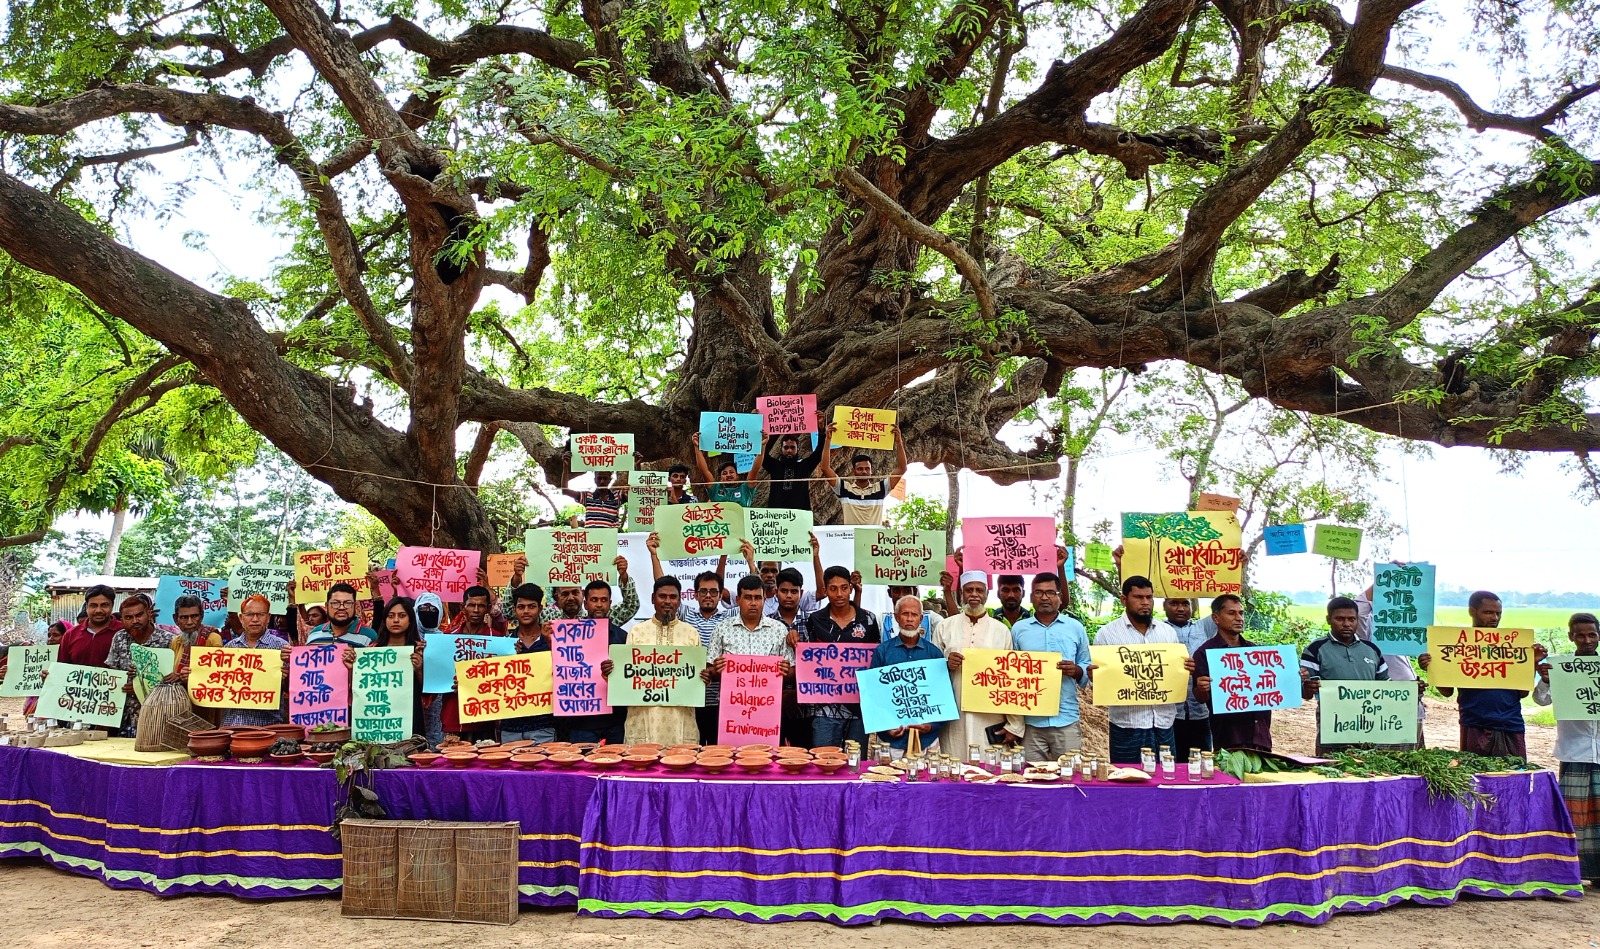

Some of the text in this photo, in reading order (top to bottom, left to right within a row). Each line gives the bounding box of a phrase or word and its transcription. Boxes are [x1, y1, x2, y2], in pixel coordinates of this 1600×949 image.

[767, 396, 803, 408] Biological
[773, 405, 804, 416] Diversity
[718, 416, 736, 426] Our
[768, 414, 804, 422] for future
[718, 424, 736, 432] Life
[770, 422, 807, 432] happy life
[575, 435, 616, 445] একটি গাছ
[718, 430, 749, 440] Depends
[578, 445, 602, 454] হাজার
[715, 441, 752, 452] Biodiversity
[582, 456, 616, 467] আবাস
[750, 510, 796, 521] Biodiversity
[683, 520, 730, 538] প্রকৃতির
[751, 527, 788, 536] Valuable
[985, 523, 1031, 536] আমরা
[549, 531, 589, 542] বাংলার
[753, 536, 786, 545] assets
[878, 532, 918, 545] Protect
[791, 545, 810, 554] them
[871, 544, 932, 561] Biodiversity
[300, 553, 325, 564] সকল
[894, 557, 909, 568] for
[986, 559, 1039, 570] করব রক্ষা
[311, 562, 353, 578] জন্য চাই
[421, 567, 447, 579] রক্ষা
[564, 563, 586, 574] ধান
[875, 564, 928, 581] happy life
[1166, 565, 1218, 579] মানে টিকে
[445, 575, 471, 592] দাবি
[1376, 566, 1423, 587] একটি
[1170, 578, 1204, 592] থাকার
[1383, 589, 1414, 606] গাছ
[1374, 606, 1417, 624] একটি
[553, 619, 596, 643] একটি
[1458, 630, 1518, 646] A Day of
[455, 638, 492, 649] সকল
[25, 649, 51, 663] Protect
[295, 644, 337, 668] একটি
[358, 649, 397, 672] প্রকৃতি
[557, 645, 588, 668] গাছ
[632, 648, 682, 665] Protect
[801, 644, 838, 666] প্রকৃতি
[1116, 646, 1166, 663] নিরাপদ
[1220, 650, 1284, 673] গাছ আছে
[24, 664, 42, 673] Every
[238, 654, 266, 672] গাছ
[504, 659, 534, 677] গাছ
[1457, 658, 1514, 679] উৎসব
[23, 672, 41, 682] Speci
[207, 668, 253, 688] প্রকৃতির
[556, 664, 593, 680] হাজার
[624, 663, 695, 679] Biodiversity
[814, 667, 837, 682] গাছ
[1124, 664, 1168, 680] খাদ্যের
[33, 681, 44, 690] Wo
[359, 670, 403, 689] রক্ষায়
[478, 674, 527, 696] প্রকৃতির
[633, 676, 678, 689] Protect
[736, 675, 768, 687] is the
[1017, 677, 1044, 691] প্রাণ
[1132, 679, 1163, 691] জন্য
[1219, 670, 1276, 693] বলেই নদী
[192, 683, 275, 704] জীবন্ত ইতিহাস
[293, 684, 334, 706] একটি
[557, 682, 596, 698] প্রাণের
[643, 689, 669, 702] Soil
[799, 683, 843, 696] আমাদের
[892, 682, 928, 698] প্রতি
[1338, 686, 1370, 700] Diver
[366, 690, 391, 705] গাছ
[464, 692, 553, 716] জীবন্ত ইতিহাস
[730, 691, 774, 706] balance
[1253, 691, 1283, 706] থাকে
[363, 705, 391, 717] হোক
[559, 698, 602, 713] আবাস
[1362, 700, 1382, 715] for
[742, 707, 757, 719] of
[355, 718, 402, 730] আমাদের
[726, 720, 779, 736] Environment
[1334, 714, 1403, 733] healthy life
